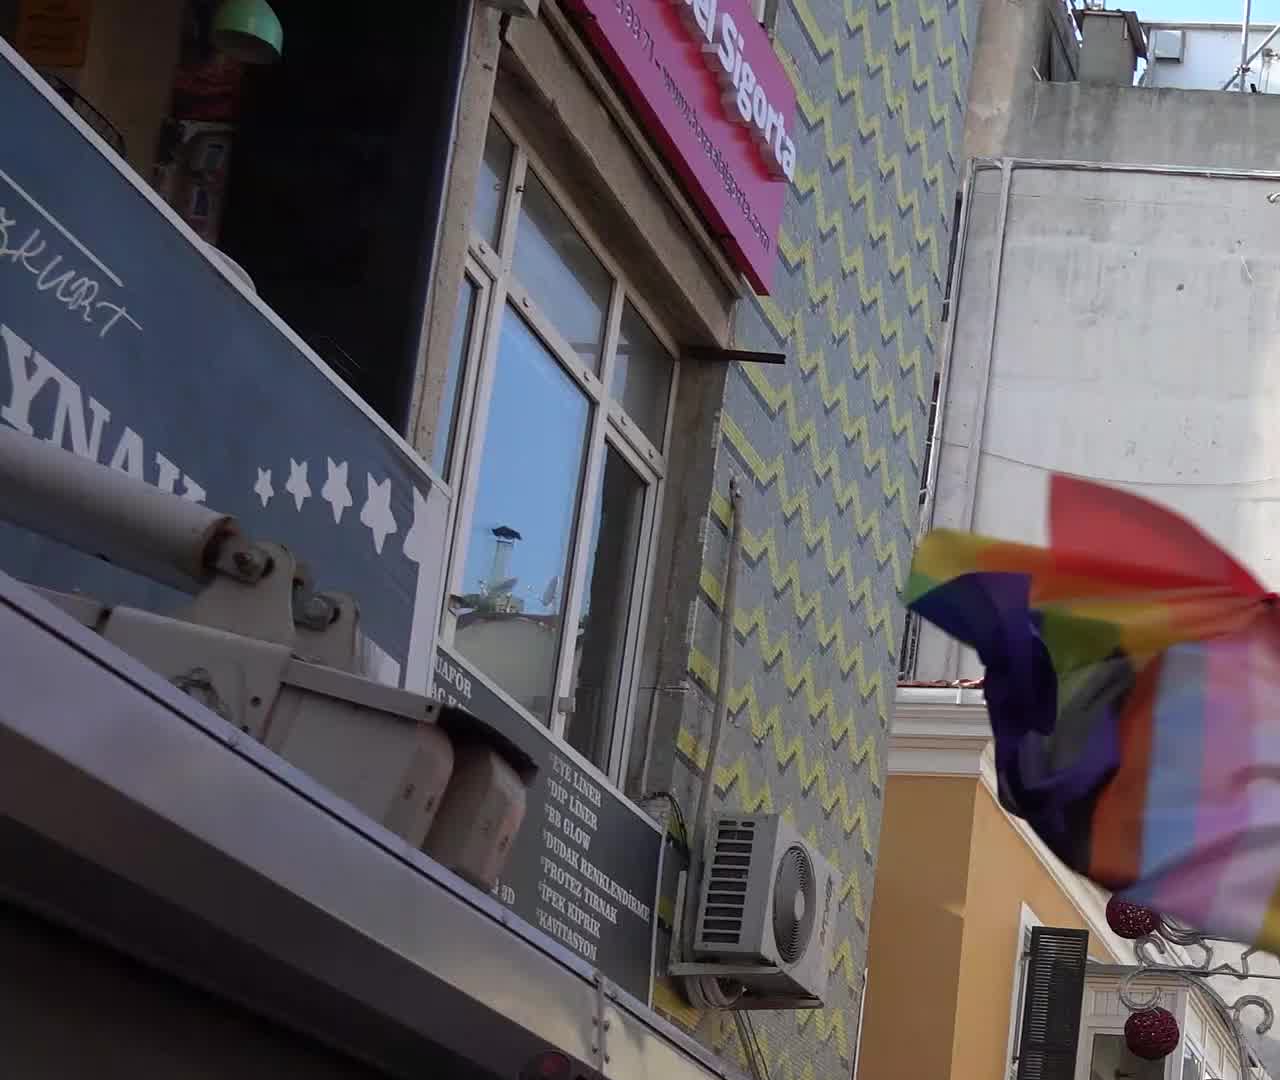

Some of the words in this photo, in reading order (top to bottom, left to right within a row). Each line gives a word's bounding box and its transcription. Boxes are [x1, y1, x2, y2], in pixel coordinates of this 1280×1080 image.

[684, 0, 718, 43] el
[718, 12, 797, 184] Sigorta
[545, 830, 580, 870] DUDAK
[562, 817, 591, 851] GLOW
[541, 878, 566, 914] İPEK
[543, 856, 582, 898] PROTEZ
[583, 886, 618, 925] TIRNAK
[539, 909, 598, 961] KAVİTASYON
